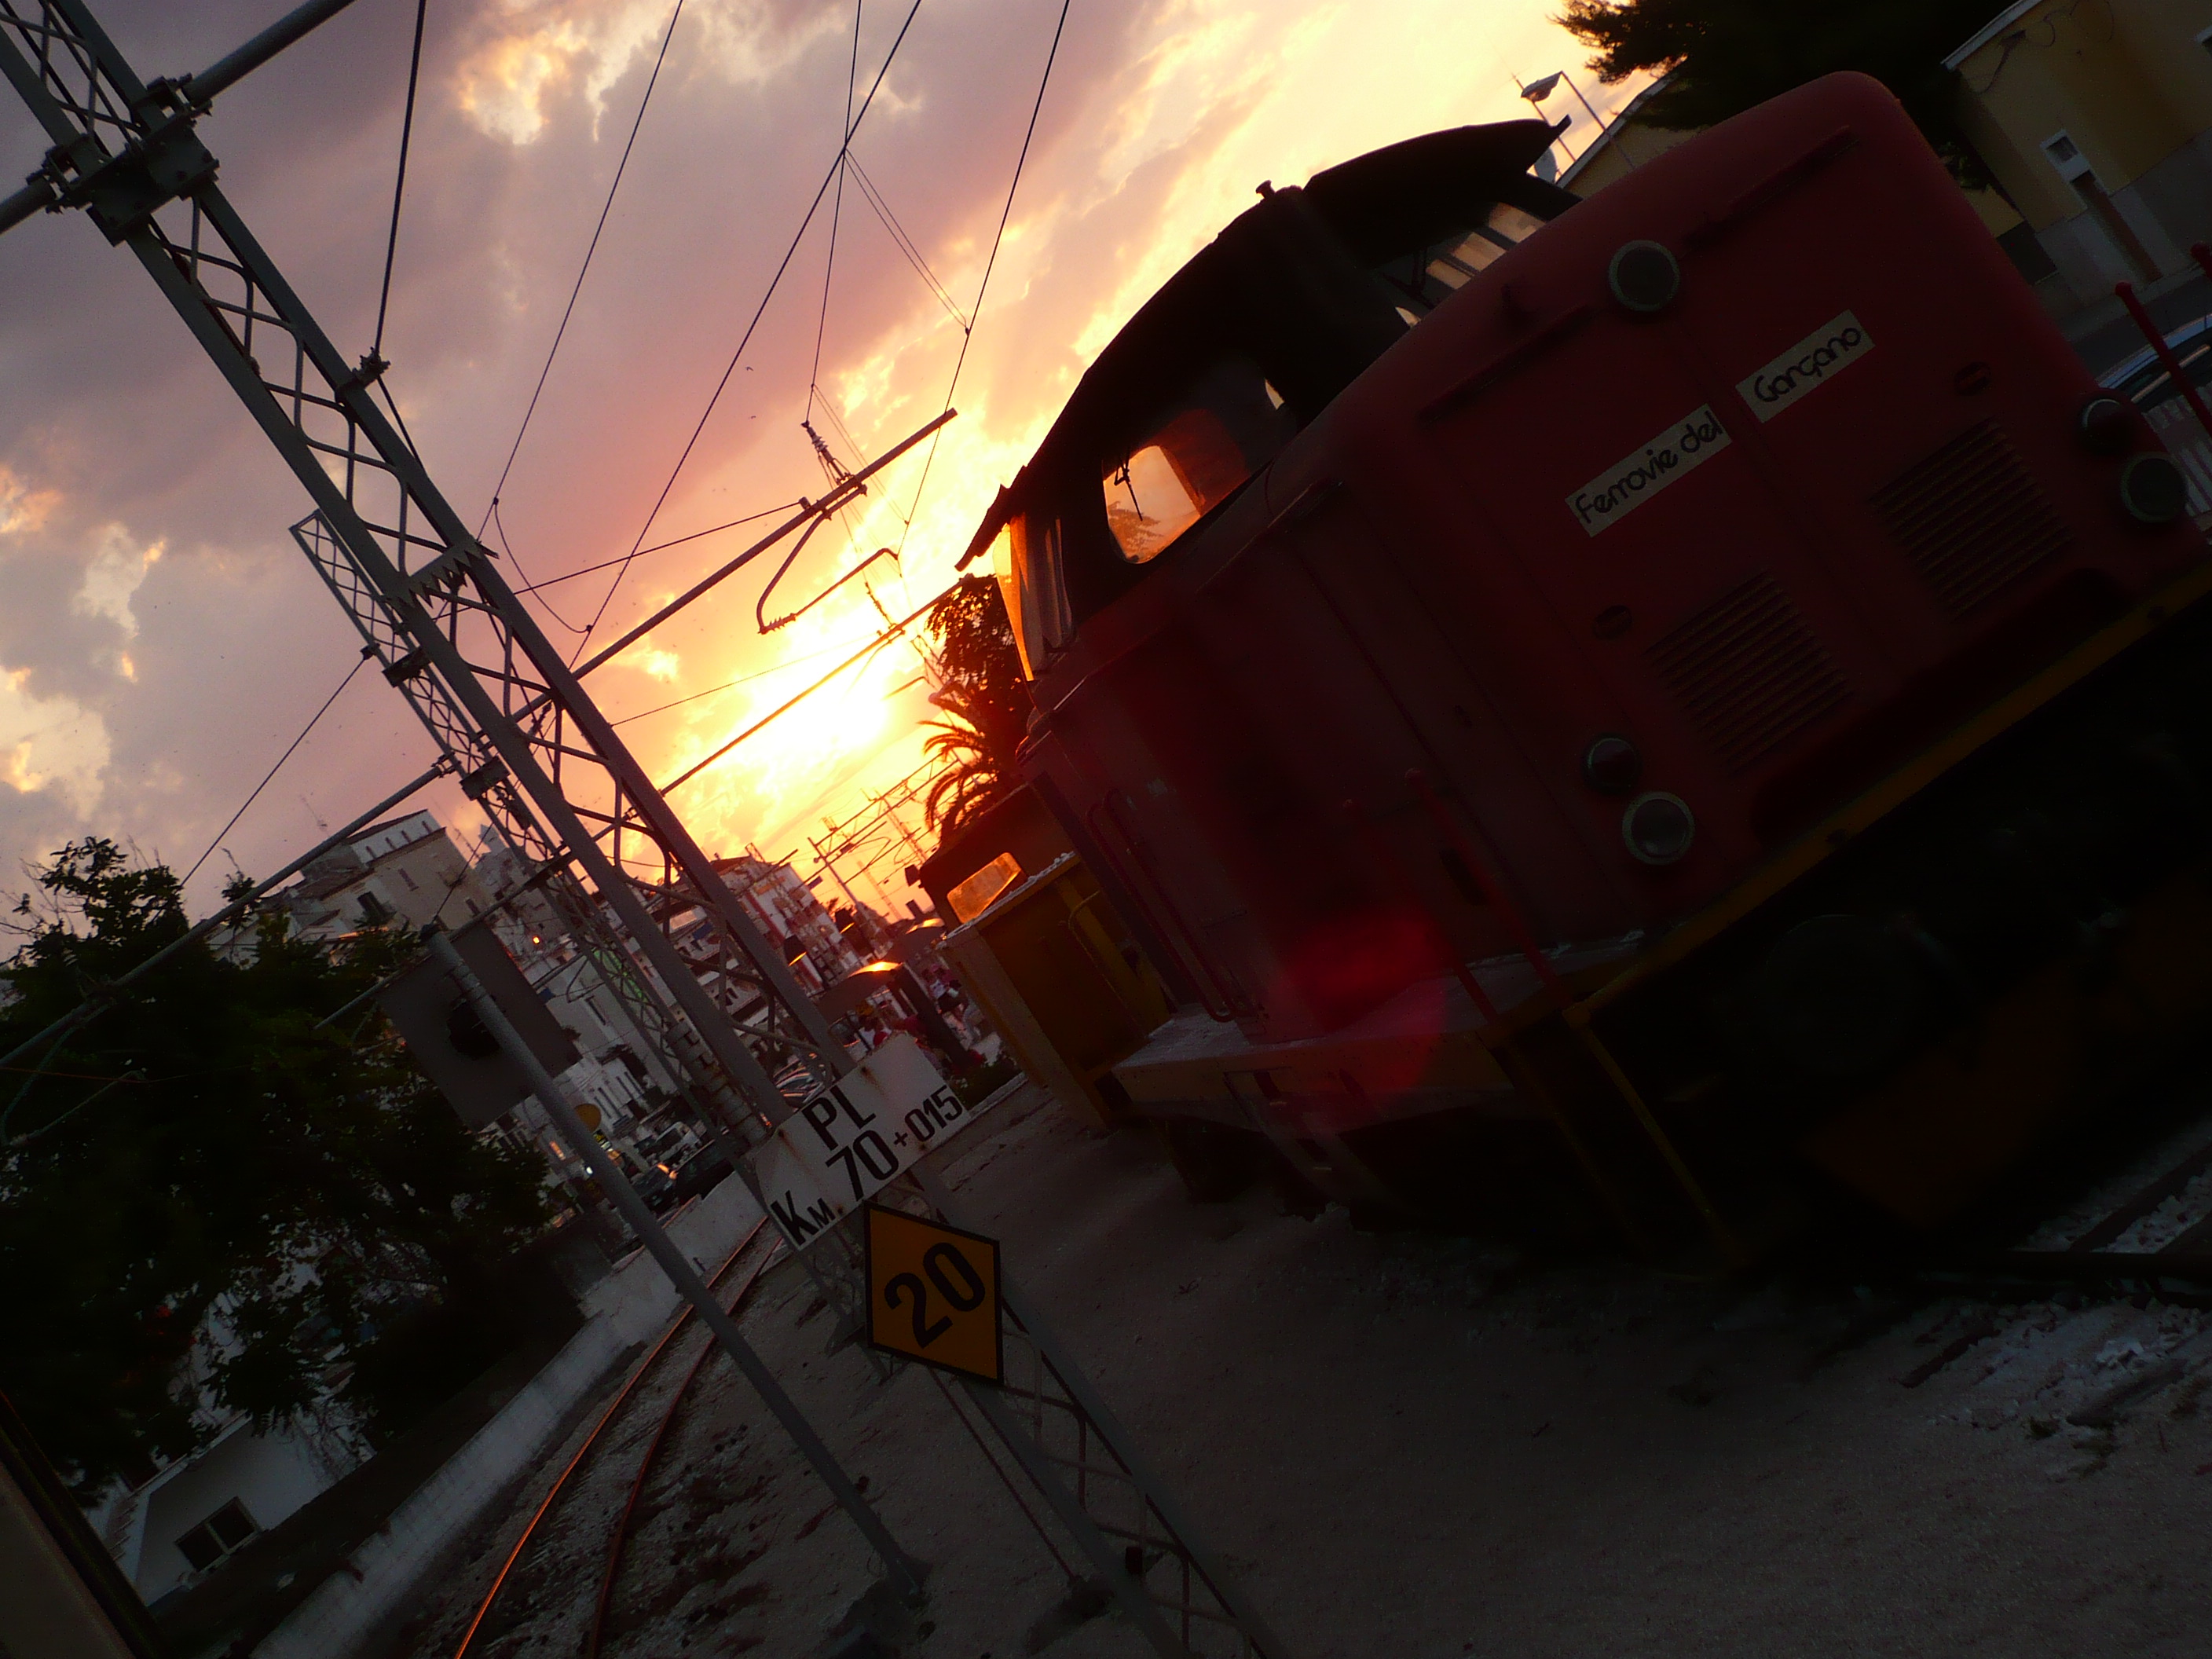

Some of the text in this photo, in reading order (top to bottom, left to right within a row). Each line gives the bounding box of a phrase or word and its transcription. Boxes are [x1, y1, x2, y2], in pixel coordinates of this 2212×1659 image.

[1574, 327, 1862, 524] Ferrovie del Gargano
[801, 1085, 876, 1151] PL
[884, 1241, 986, 1349] 20
